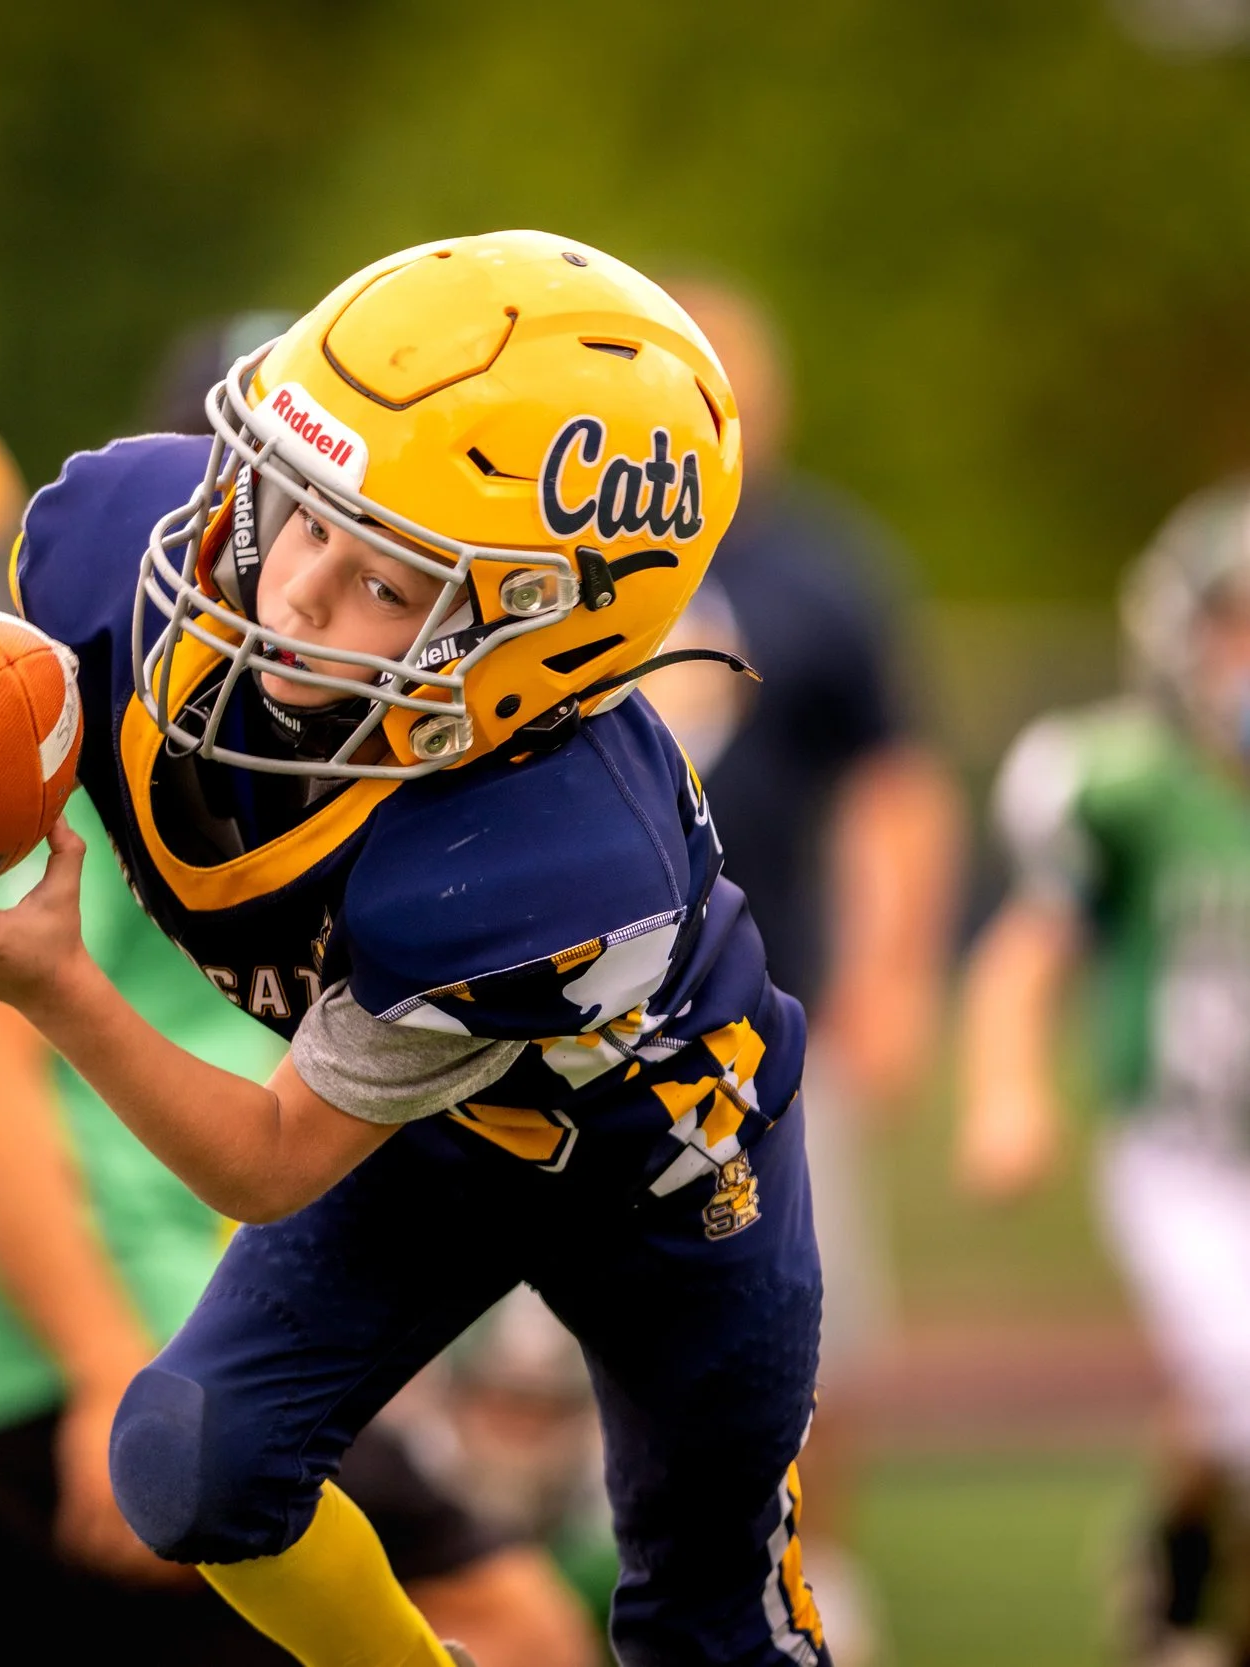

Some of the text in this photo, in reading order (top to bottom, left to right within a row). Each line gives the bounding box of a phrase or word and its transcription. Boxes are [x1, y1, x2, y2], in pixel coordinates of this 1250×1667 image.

[272, 389, 354, 468] Riddell
[539, 415, 704, 543] Cats
[234, 463, 260, 568] Riddell
